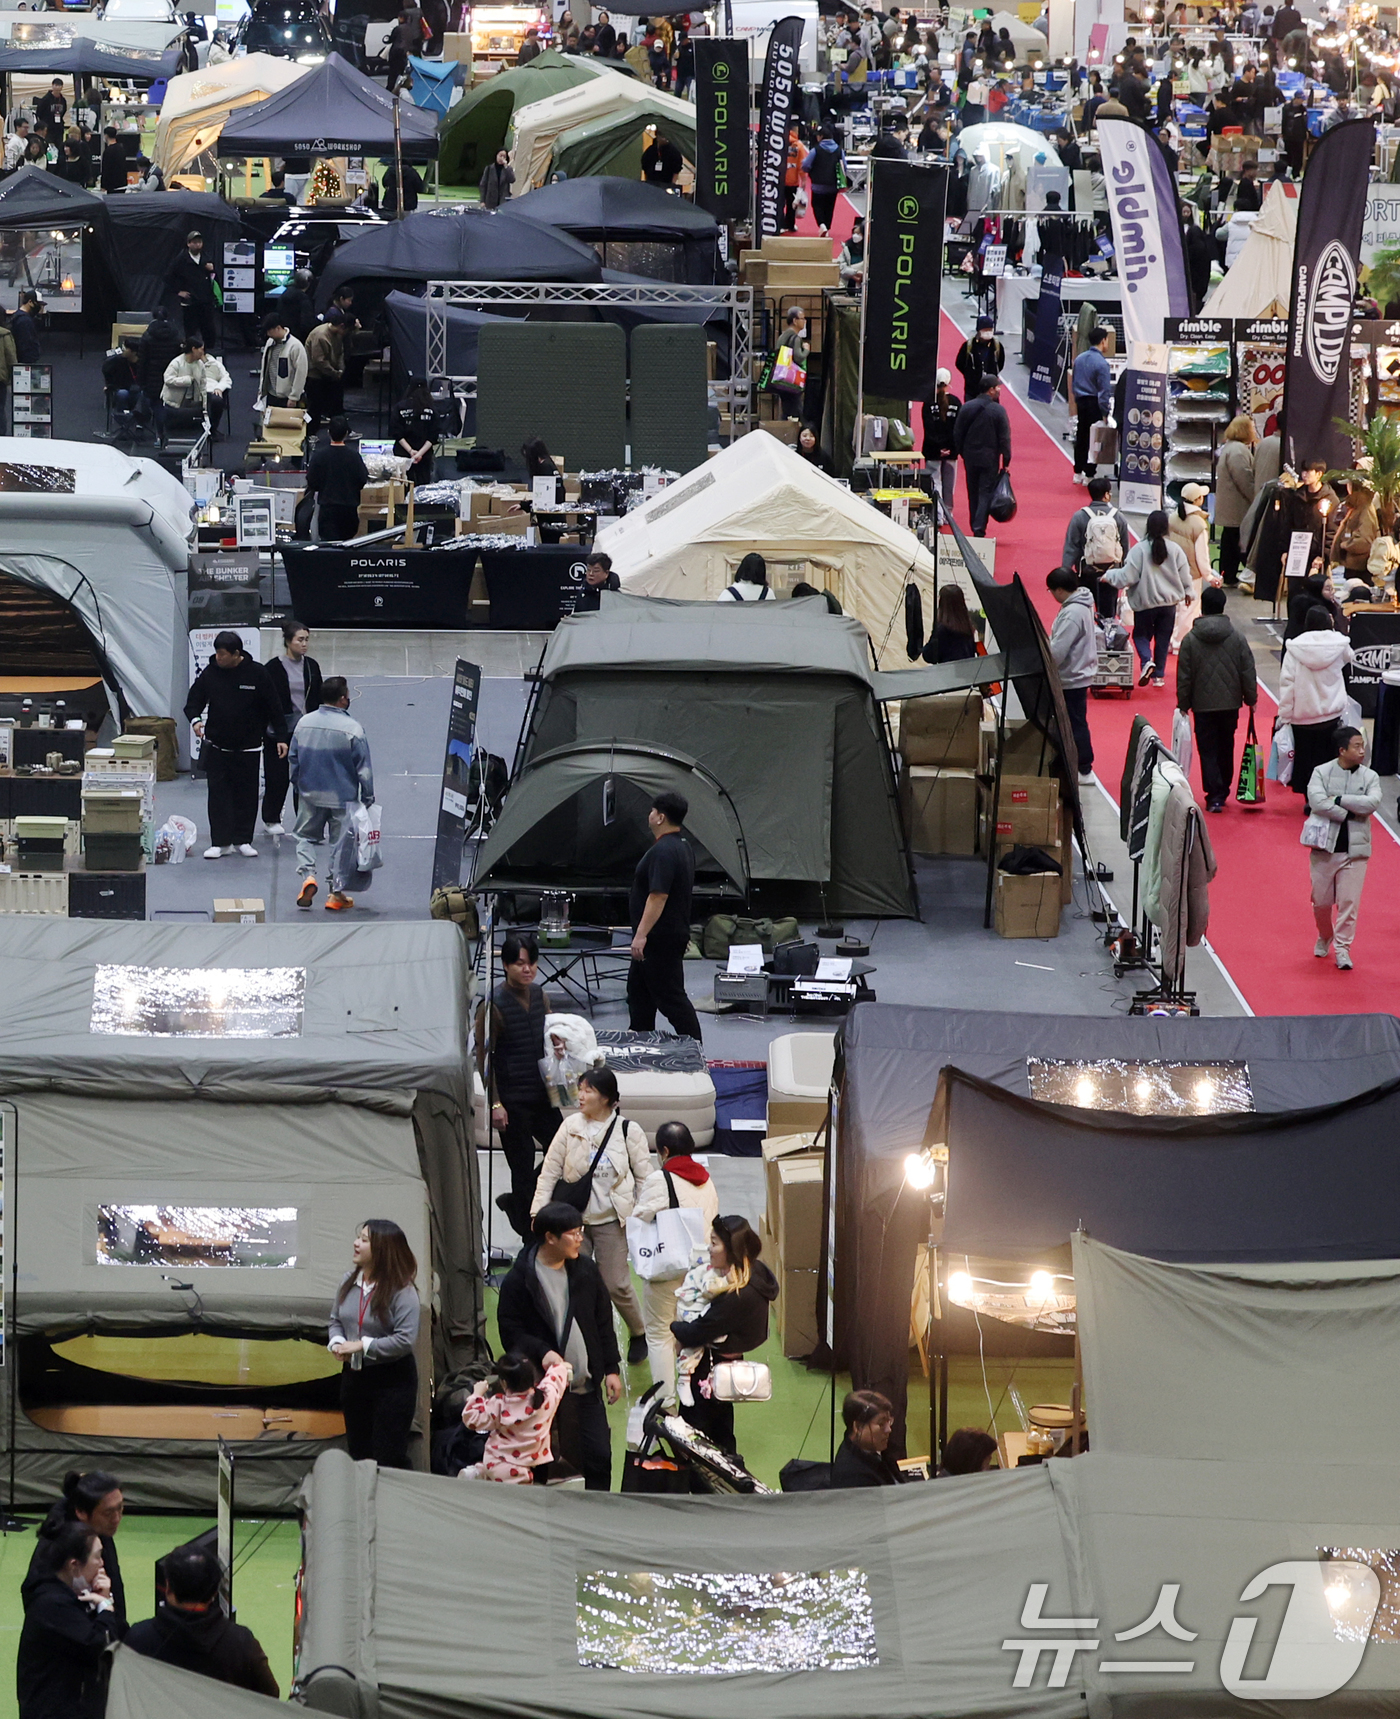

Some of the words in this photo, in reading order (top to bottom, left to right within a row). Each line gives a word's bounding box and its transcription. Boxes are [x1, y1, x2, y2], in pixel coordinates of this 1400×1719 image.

[714, 91, 728, 196] POLARIS
[761, 42, 794, 236] 5050WORKSHO
[327, 143, 362, 152] WORKSHOP
[890, 234, 915, 370] POLARIS
[1178, 319, 1222, 333] rimble
[350, 558, 407, 567] POLARIS
[215, 567, 249, 575] BUNKER
[214, 574, 249, 582] SHELTER
